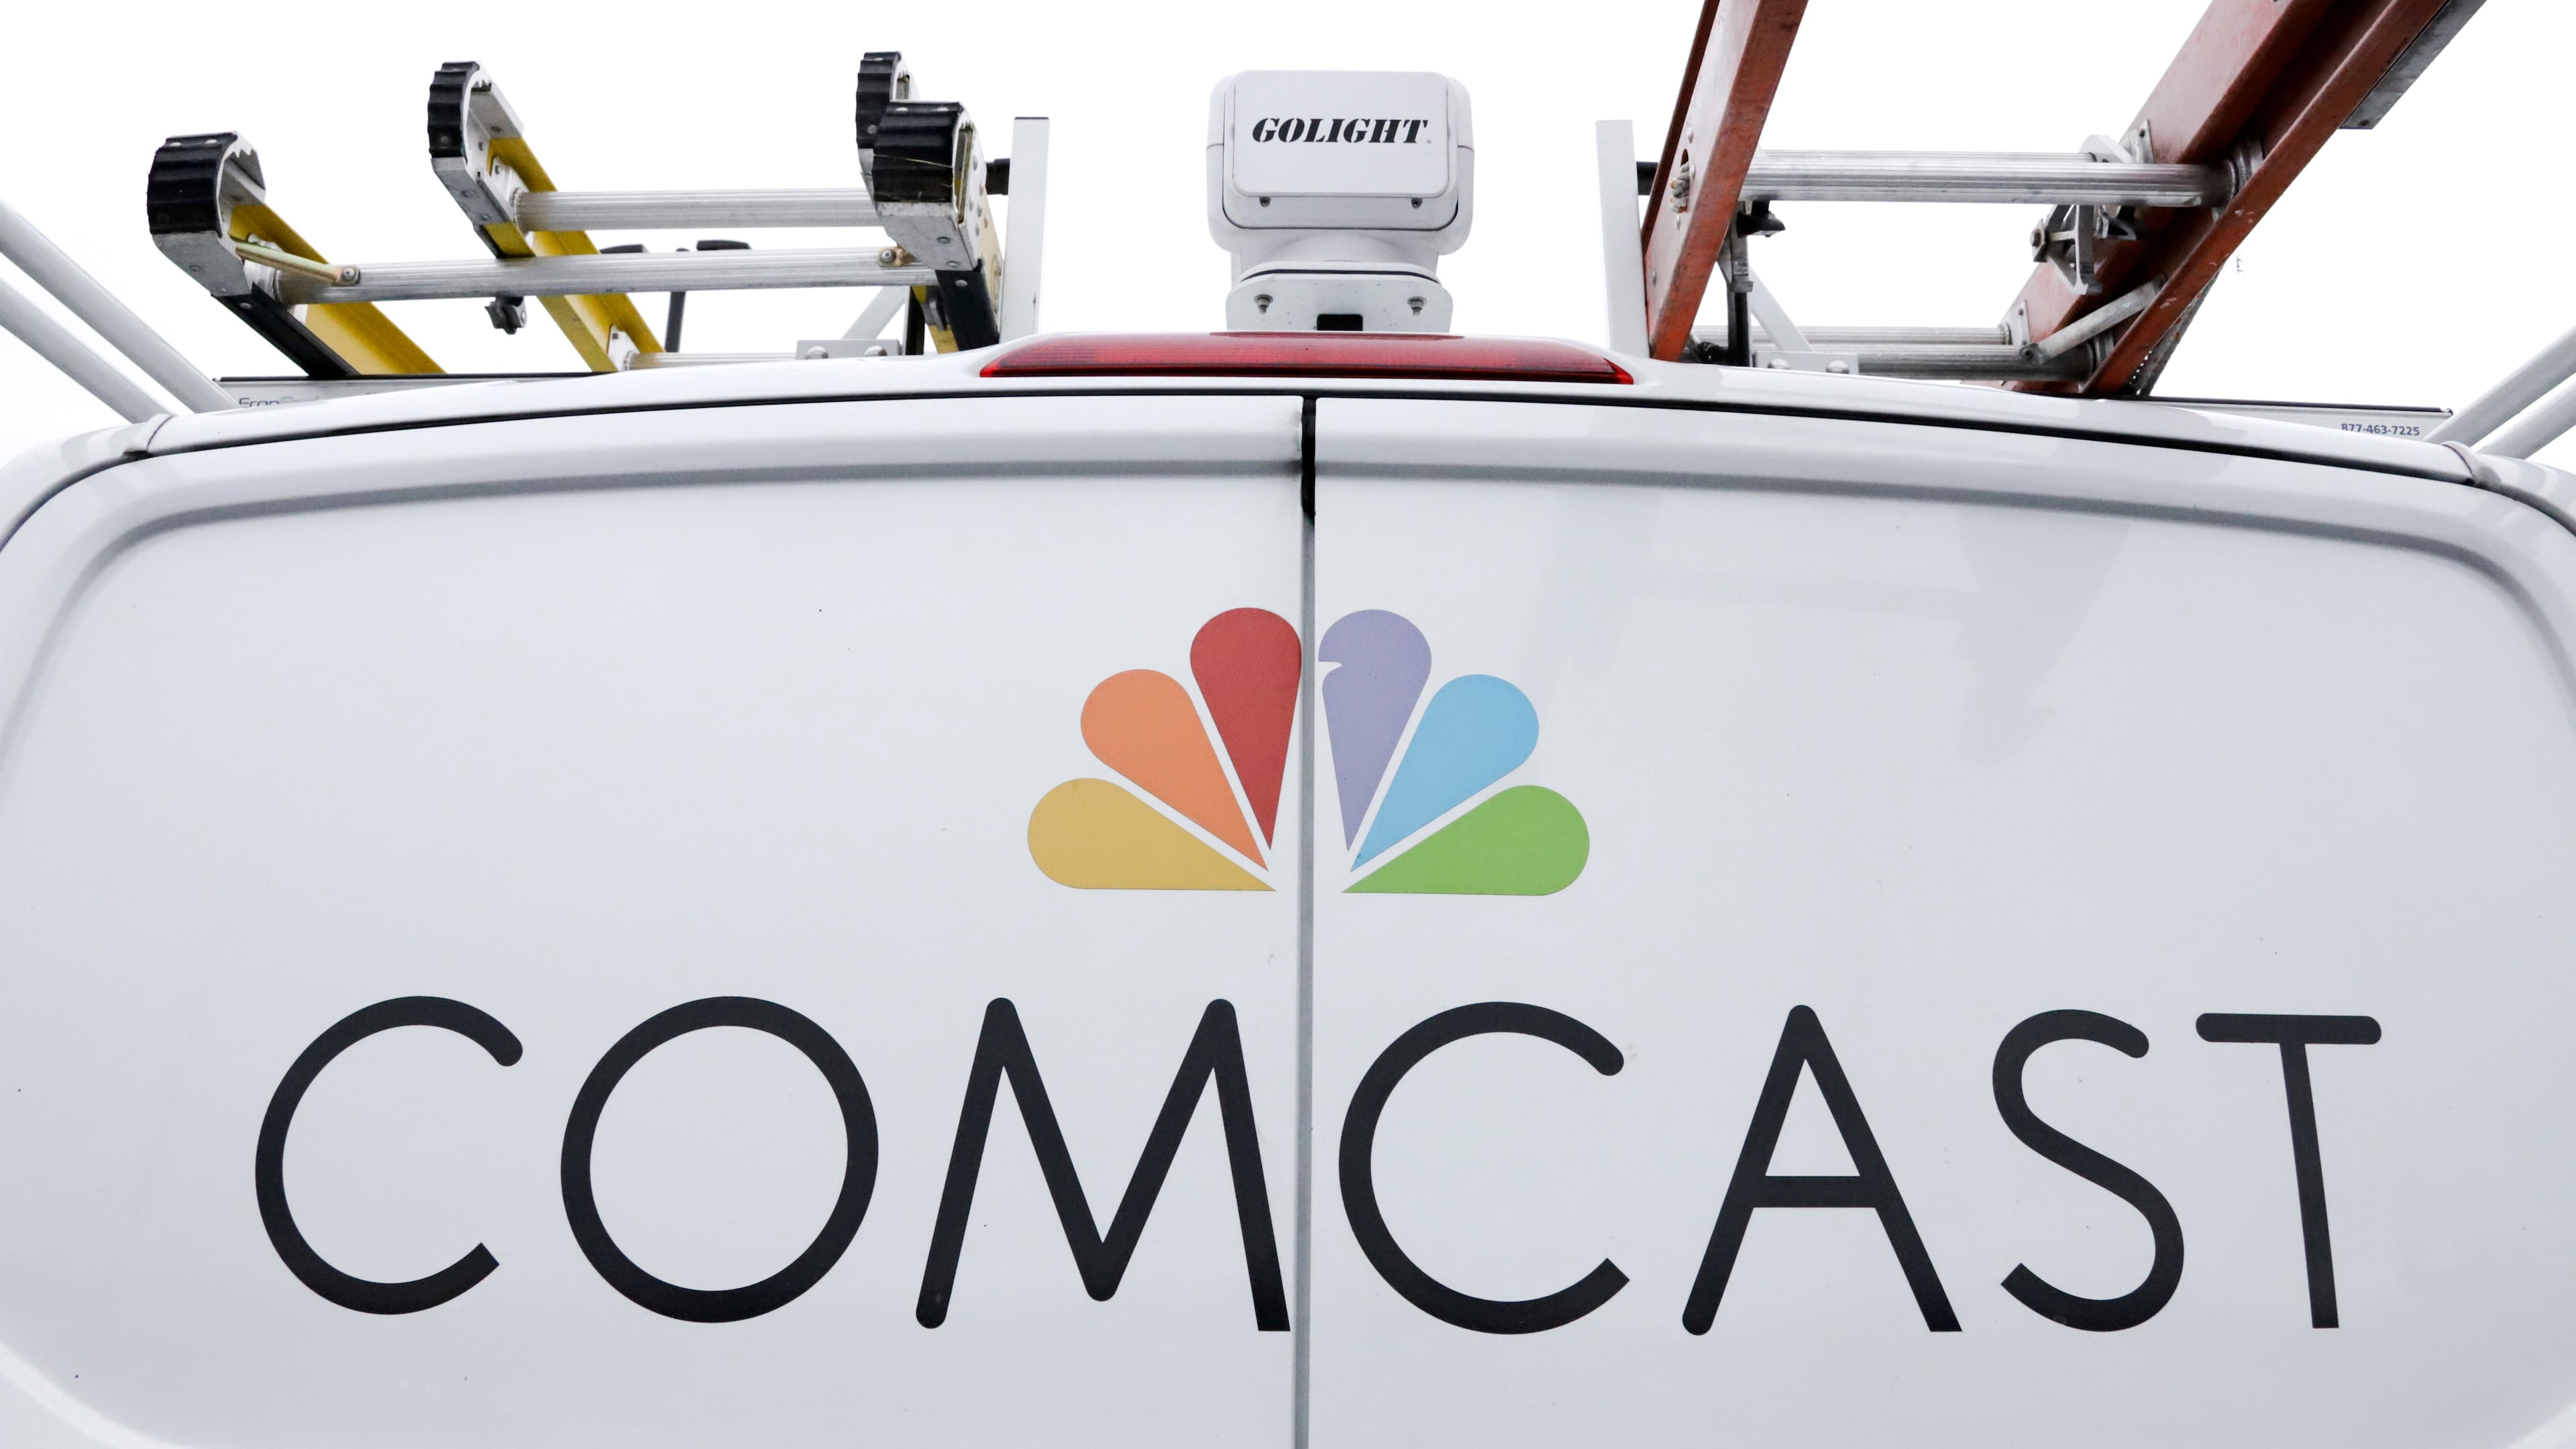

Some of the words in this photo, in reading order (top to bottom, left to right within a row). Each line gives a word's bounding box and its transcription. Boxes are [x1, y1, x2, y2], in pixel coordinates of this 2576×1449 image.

[1252, 117, 1428, 144] GOLIGHT
[2341, 423, 2421, 436] 877-463-7225
[255, 996, 2381, 1335] COMCAST
